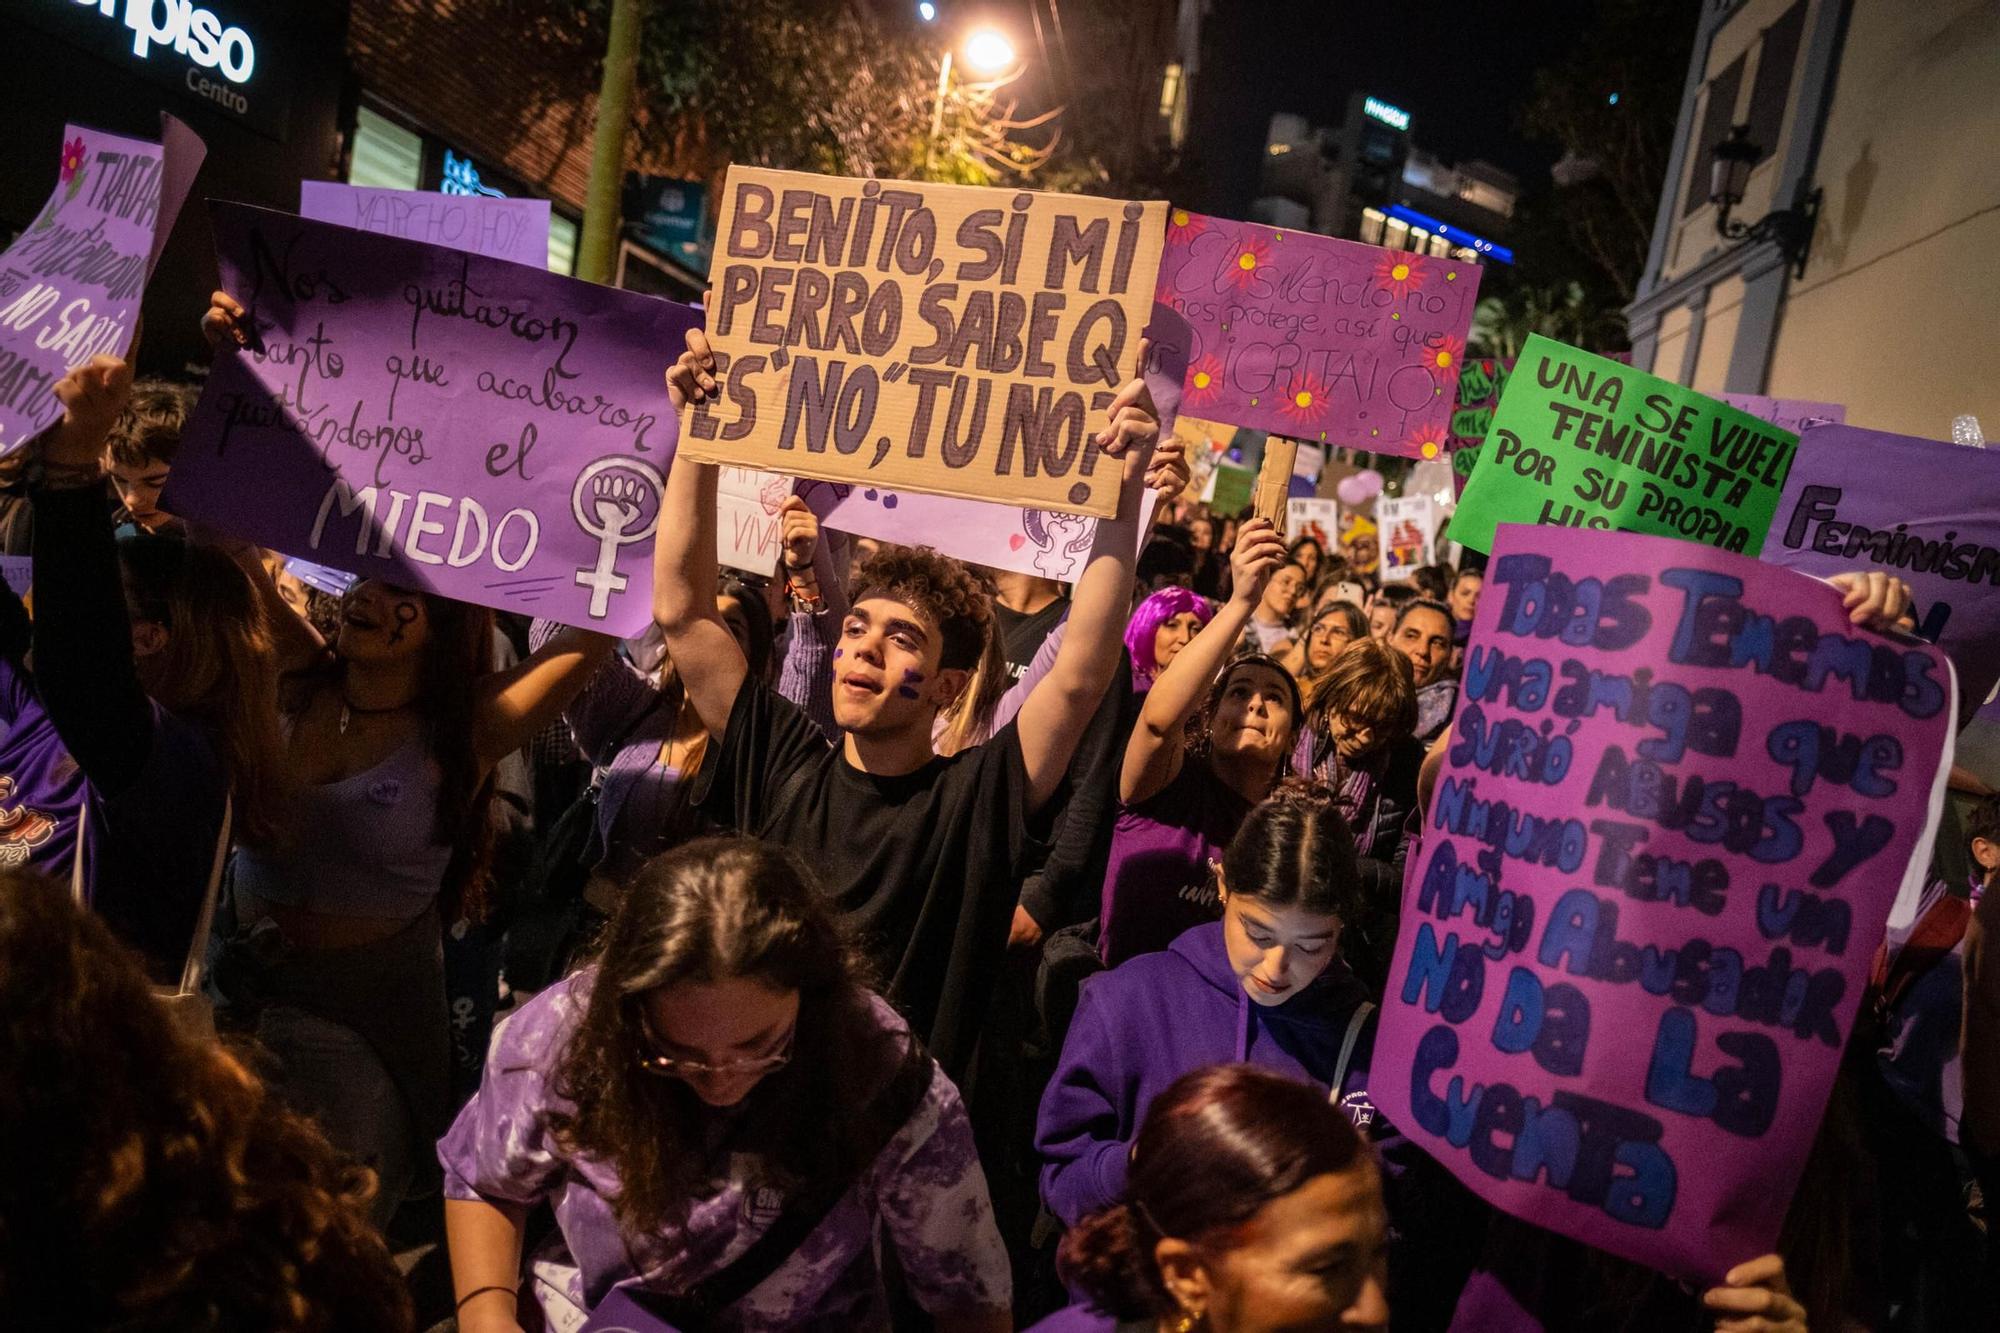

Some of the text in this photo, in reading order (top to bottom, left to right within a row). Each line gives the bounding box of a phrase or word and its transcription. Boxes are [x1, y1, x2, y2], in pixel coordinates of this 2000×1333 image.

[72, 0, 255, 83] piso
[185, 67, 249, 115] Centro
[1044, 201, 1144, 294] MI
[1174, 231, 1241, 294] El
[1406, 291, 1446, 314] no
[0, 283, 60, 332] NO
[404, 255, 582, 380] quitaron
[716, 264, 1127, 388] PERRO SABE Q
[1172, 297, 1218, 322] nos
[1393, 324, 1446, 358] que
[386, 354, 450, 421] que
[477, 367, 659, 452] acabaron
[689, 351, 767, 442] ES
[906, 369, 993, 469] TU
[1537, 356, 1625, 408] UNA
[1635, 394, 1700, 443] SE
[485, 423, 538, 481] el
[1494, 428, 1558, 486] POR
[1574, 467, 1628, 511] SU
[1637, 481, 1751, 553] PROPIA
[1549, 401, 1749, 508] FEMINISTA
[309, 476, 541, 573] MIEDO
[1767, 720, 1903, 798] que
